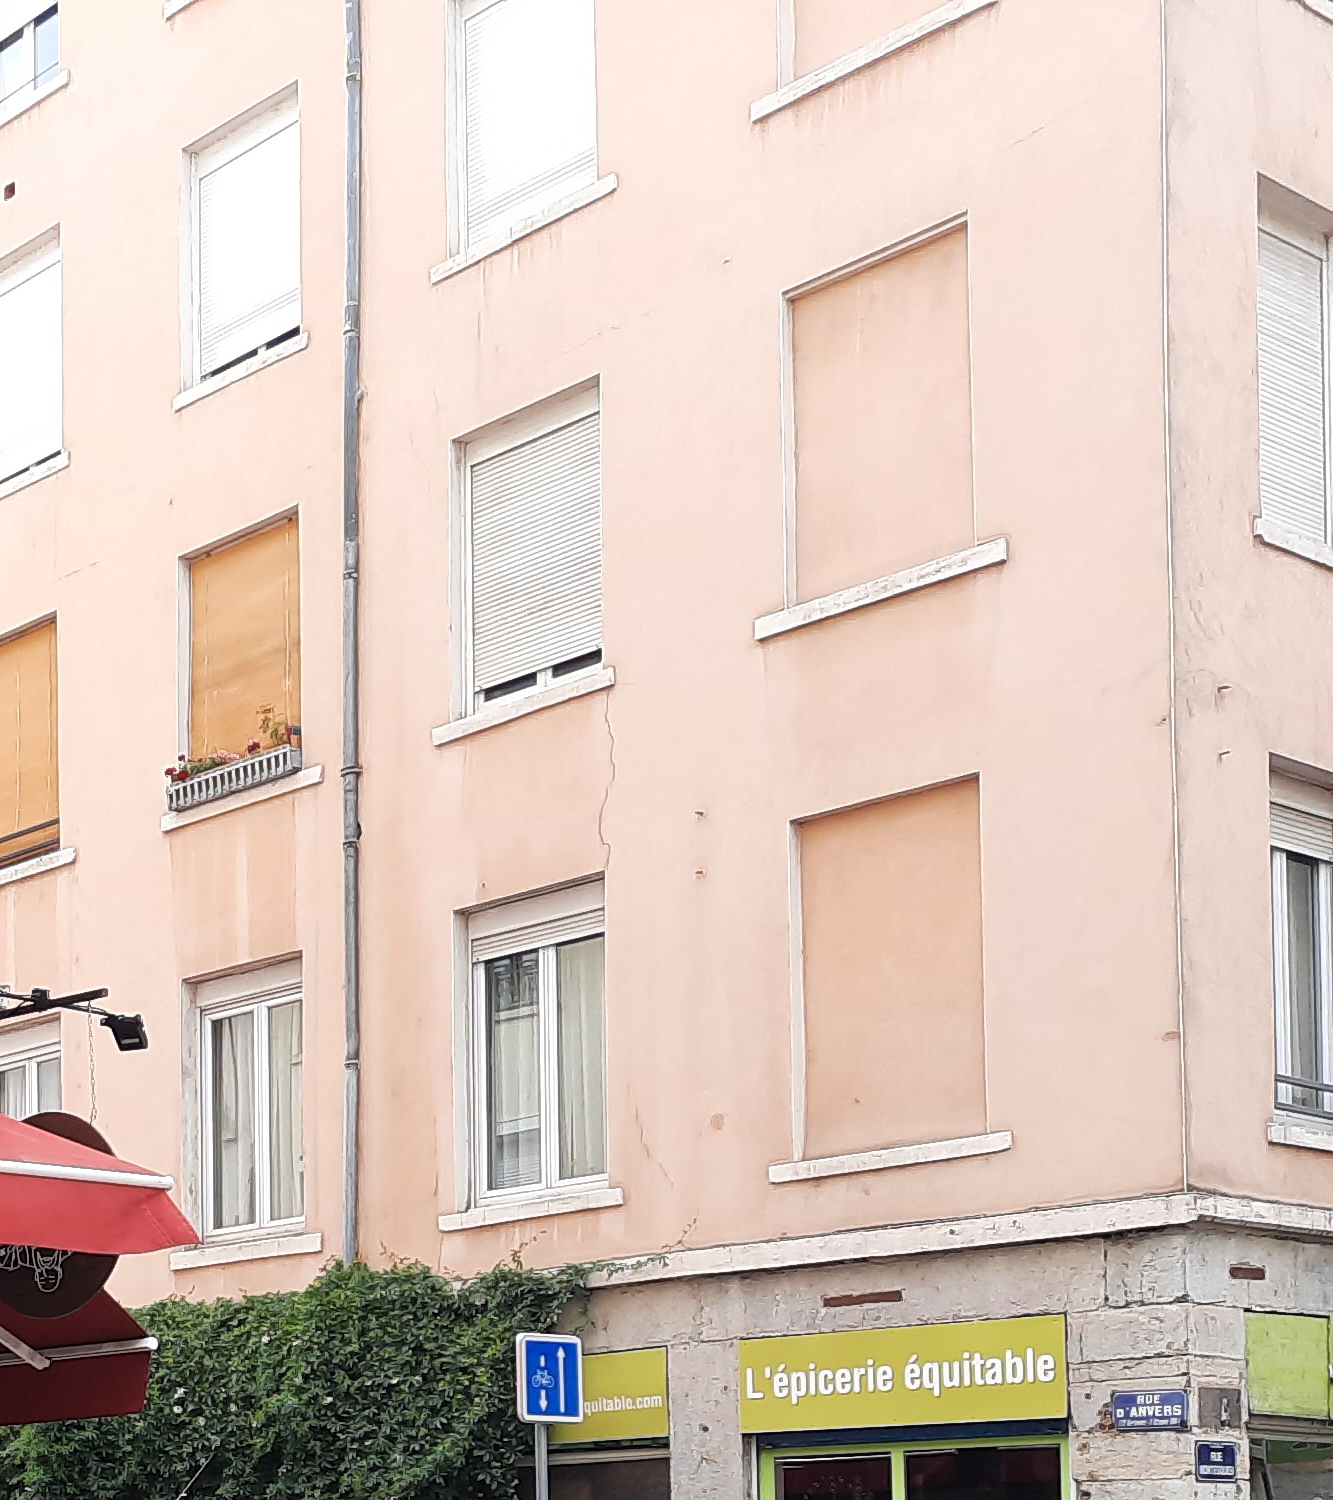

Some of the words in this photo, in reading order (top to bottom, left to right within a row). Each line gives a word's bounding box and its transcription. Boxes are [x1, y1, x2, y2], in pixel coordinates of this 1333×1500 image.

[745, 1357, 893, 1404] L'épicerie
[904, 1347, 1055, 1397] équitable
[583, 1394, 663, 1417] quitable.com
[1136, 1395, 1161, 1405] RUE
[1116, 1405, 1182, 1418] D'ANVERS
